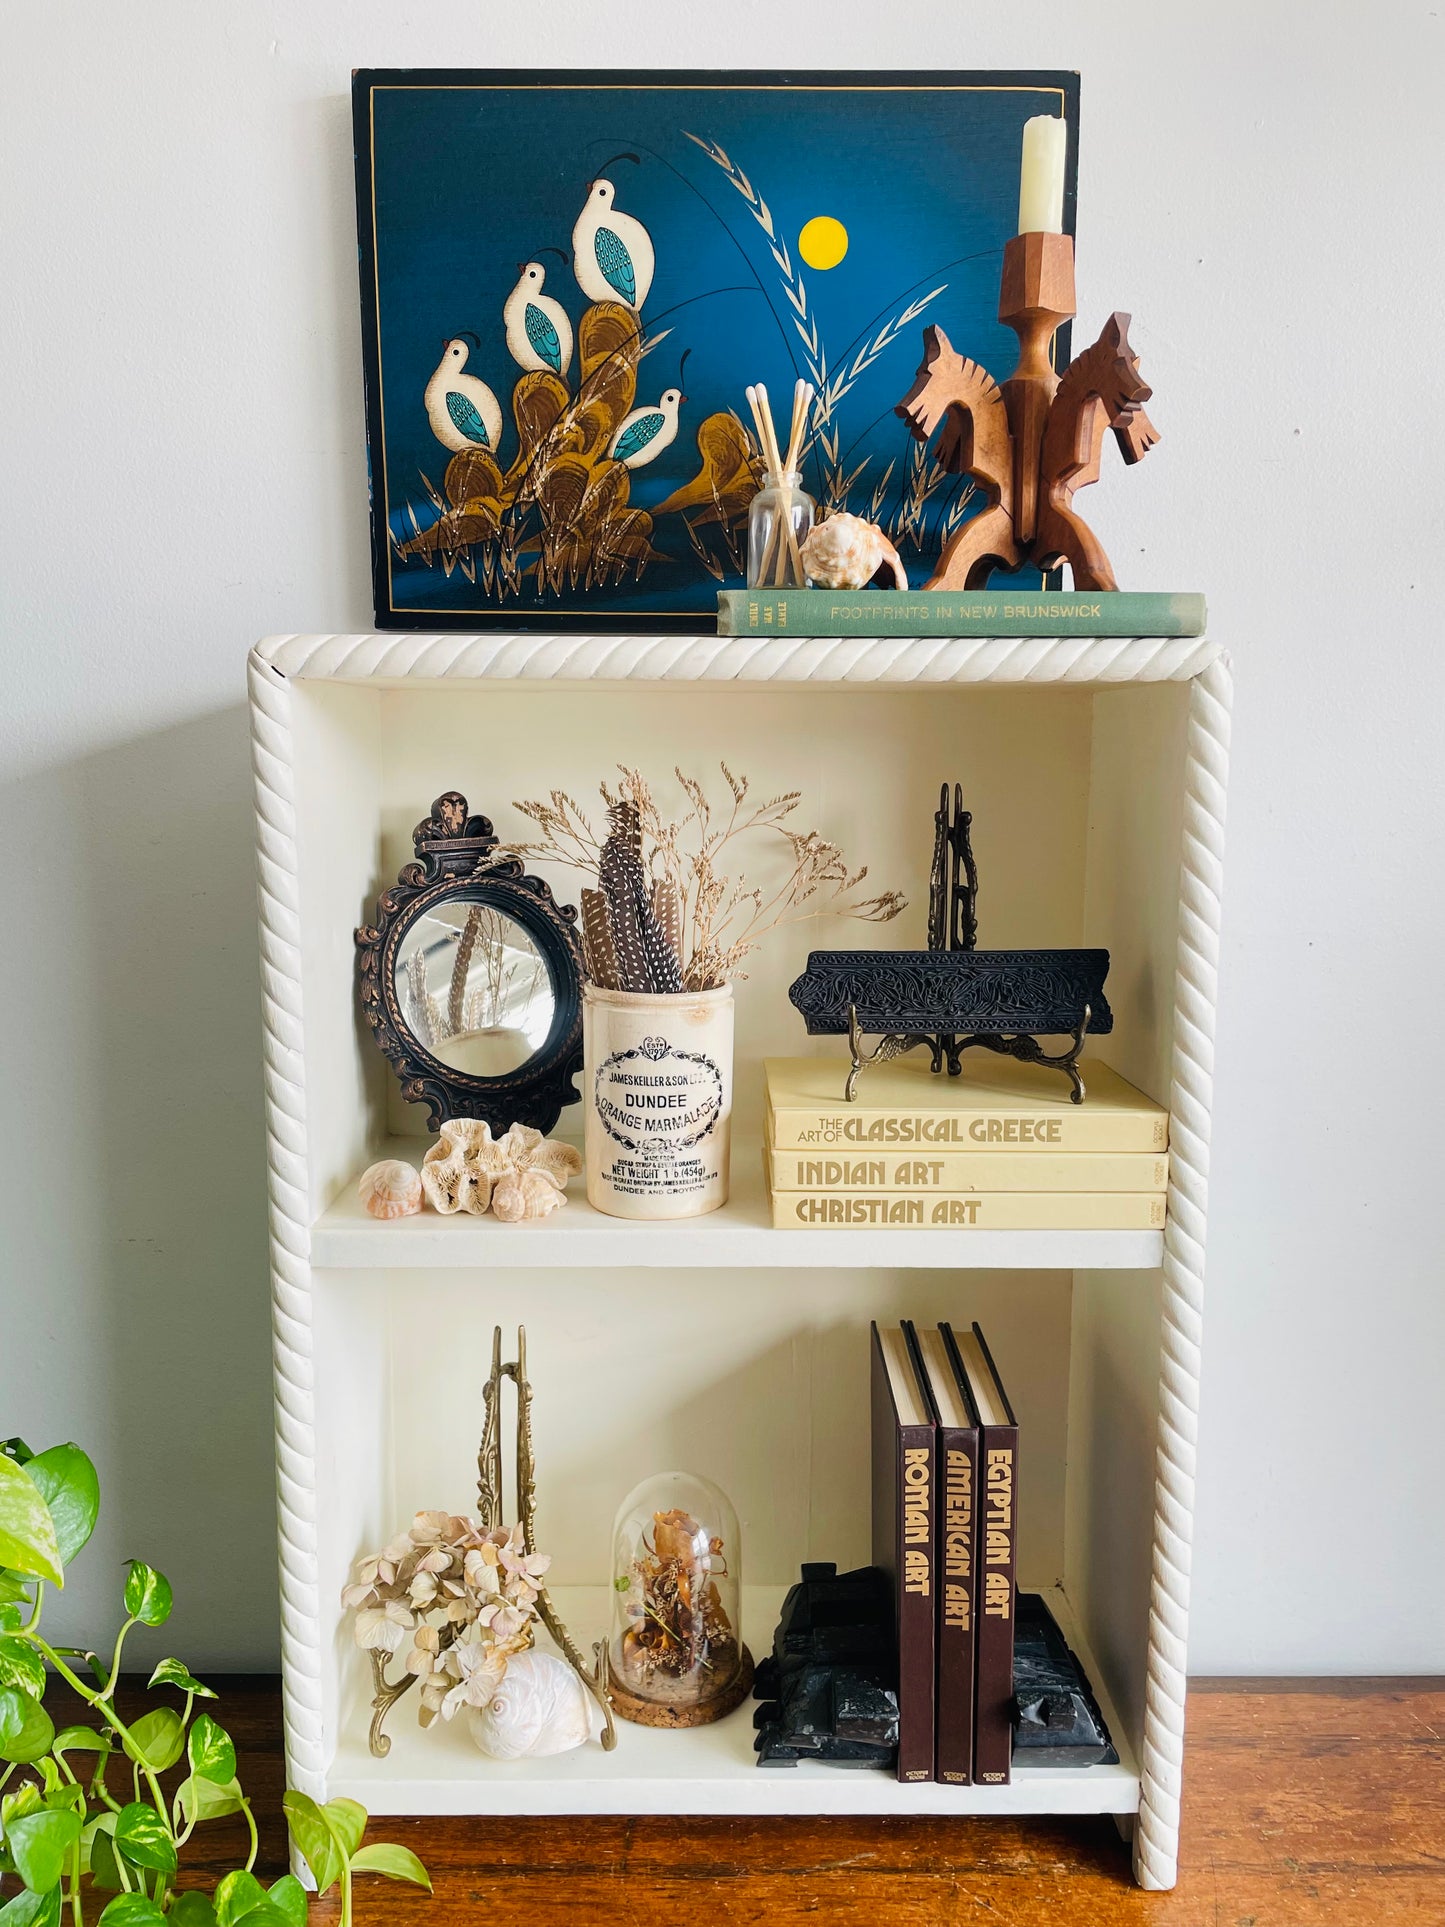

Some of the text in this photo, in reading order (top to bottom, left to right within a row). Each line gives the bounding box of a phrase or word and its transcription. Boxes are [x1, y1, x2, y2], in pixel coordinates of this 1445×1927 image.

[831, 604, 1101, 620] FOOTPRINTS IN NEW BRUNSWICK
[648, 1048, 663, 1056] 1797
[609, 1072, 633, 1086] JAMES
[633, 1075, 665, 1087] KEILLER
[665, 1076, 671, 1086] &
[672, 1075, 688, 1086] SON
[625, 1093, 687, 1109] DUNDEE
[600, 1096, 716, 1132] ORANGE MARMALADE
[819, 1118, 843, 1130] THE
[843, 1118, 1063, 1143] CLASSICAL GREECE
[797, 1130, 843, 1143] ART OF
[612, 1164, 625, 1176] NET
[628, 1167, 659, 1179] WEIGHT
[664, 1169, 669, 1179] 1
[681, 1165, 706, 1178] (454g)
[797, 1161, 945, 1185] INDIAN ART
[613, 1184, 645, 1195] DUNDEE
[666, 1184, 705, 1195] CROYDON
[795, 1199, 982, 1224] CHRISTIAN ART
[904, 1448, 930, 1597] ROMAN ART
[945, 1450, 972, 1632] AMERICAN ART
[985, 1449, 1013, 1619] EGYPTIAN ART
